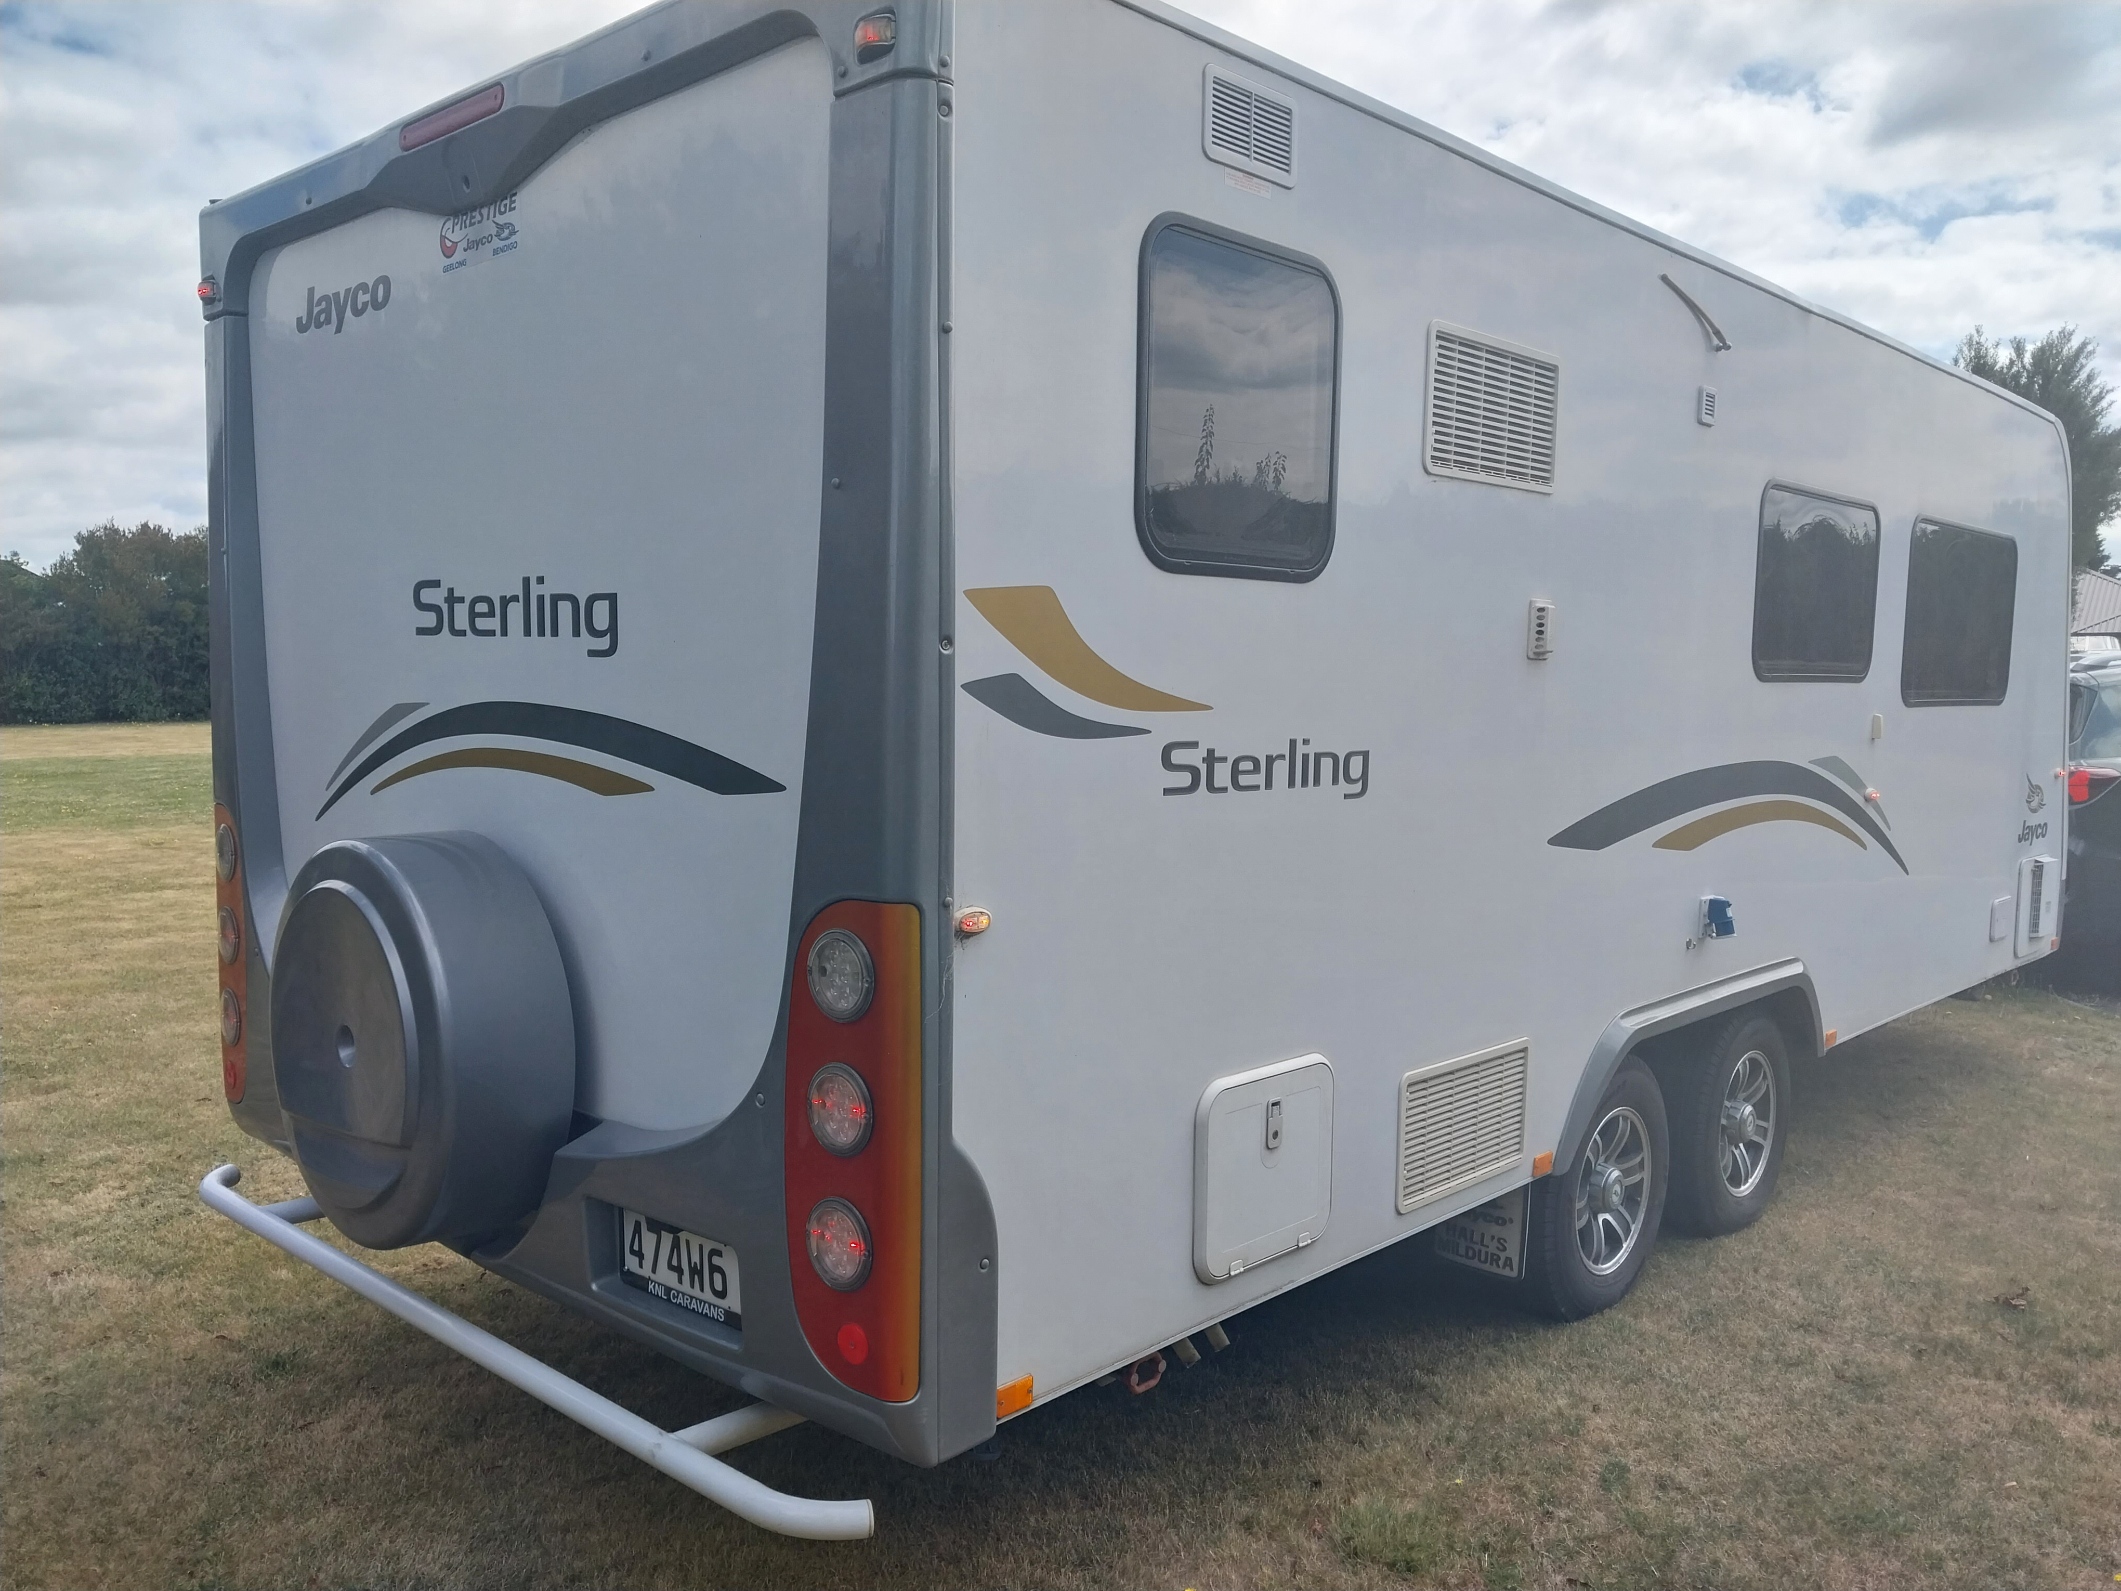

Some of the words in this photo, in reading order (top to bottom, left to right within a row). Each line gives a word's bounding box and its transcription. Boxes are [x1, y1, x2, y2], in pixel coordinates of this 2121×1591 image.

[451, 192, 517, 234] PRESTIGE
[463, 234, 493, 253] Jayco
[492, 241, 518, 256] BENDIGO
[442, 259, 467, 274] GEELONG
[296, 274, 392, 335] Jayco
[413, 575, 618, 658] Sterling
[1161, 738, 1370, 800] Sterling
[2018, 820, 2048, 846] Jayco
[628, 1219, 728, 1300] 474W6
[648, 1280, 668, 1299] KNL
[670, 1290, 725, 1322] CARAVANS
